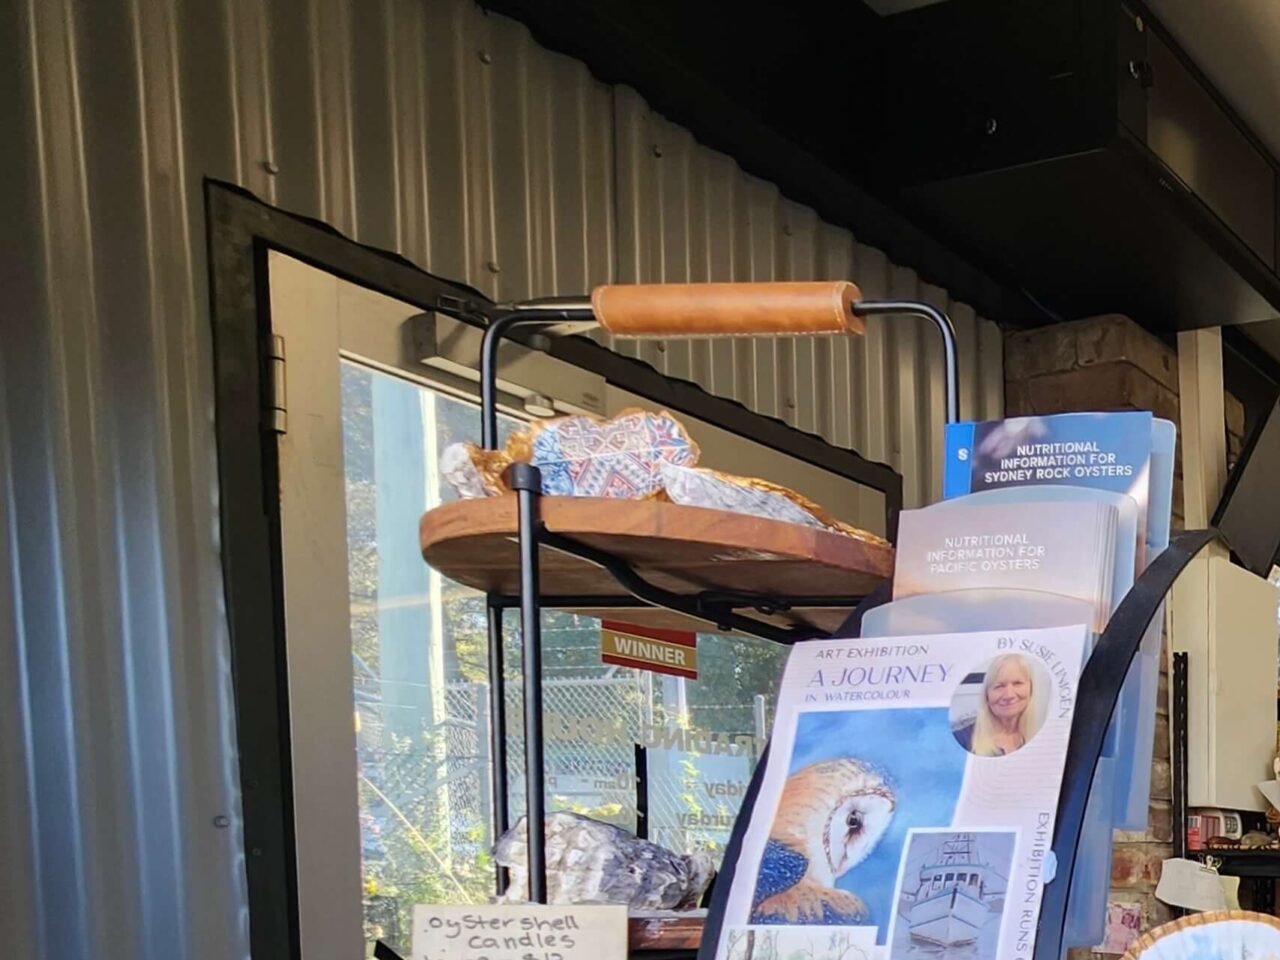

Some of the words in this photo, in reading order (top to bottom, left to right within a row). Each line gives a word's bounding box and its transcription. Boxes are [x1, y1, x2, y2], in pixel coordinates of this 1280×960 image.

[1017, 441, 1100, 456] NUTRITIONAL
[1001, 455, 1086, 469] INFORMATION
[1090, 453, 1116, 464] FOR
[985, 469, 1033, 483] SYDNEY
[1036, 467, 1070, 479] ROCK
[1075, 465, 1133, 477] OYSTERS
[945, 533, 1029, 548] NUTRITIONAL
[928, 547, 1015, 562] INFORMATION
[1019, 545, 1046, 556] FOR
[930, 561, 978, 574] PACIFIC
[981, 559, 1040, 571] OYSTERS
[614, 636, 686, 666] WINNER
[816, 648, 844, 659] ART
[847, 644, 929, 659] EXHIBITION
[997, 637, 1015, 649] BY
[1020, 639, 1056, 664] SUSIE
[807, 669, 824, 687] A
[832, 663, 954, 687] JOURNEY
[805, 693, 817, 702] IN
[825, 690, 911, 701] WATERCOLOUR
[1024, 812, 1050, 903] EXHIBITION
[1016, 910, 1033, 952] RUNS
